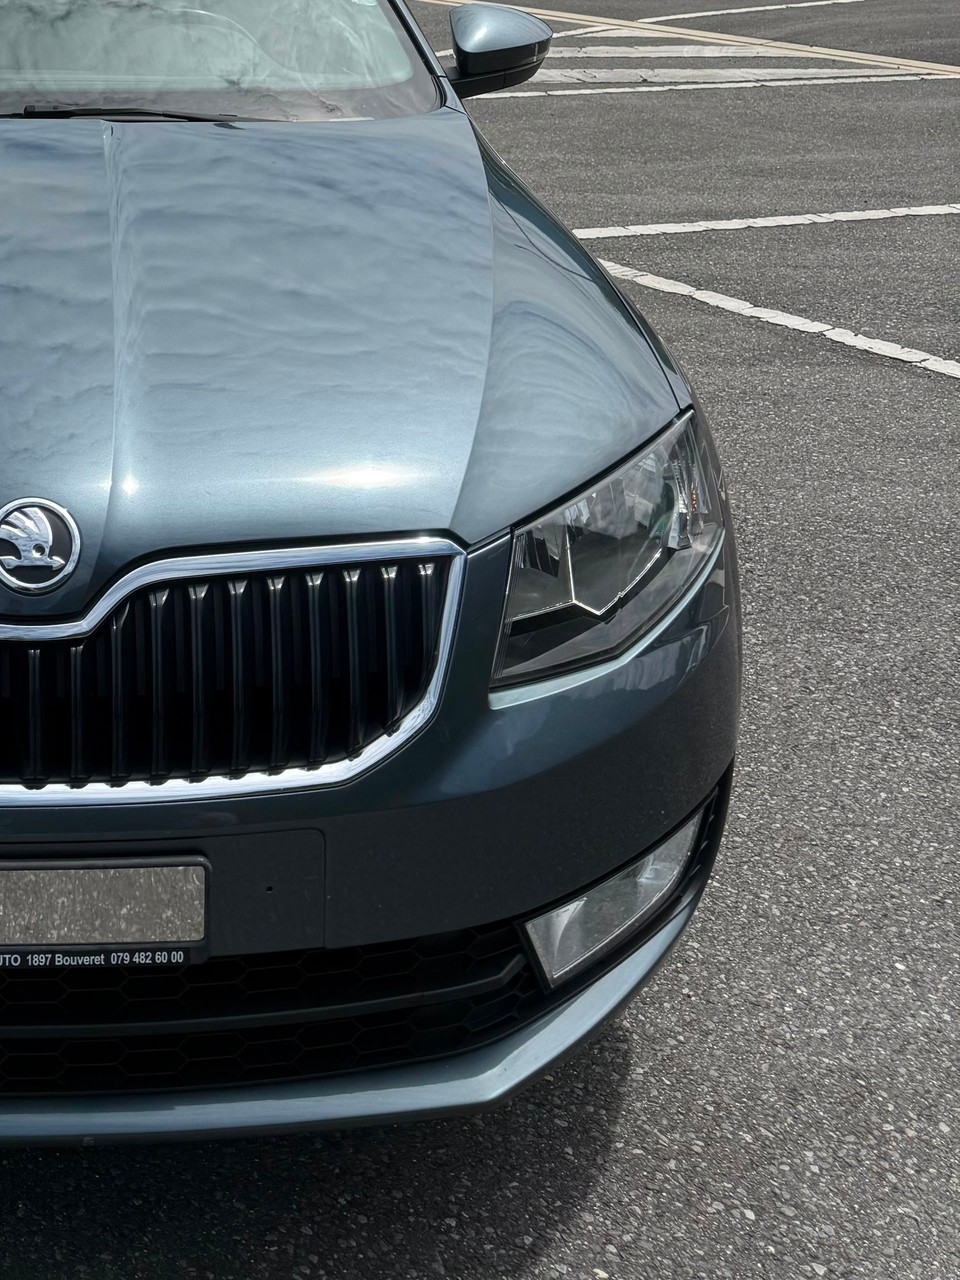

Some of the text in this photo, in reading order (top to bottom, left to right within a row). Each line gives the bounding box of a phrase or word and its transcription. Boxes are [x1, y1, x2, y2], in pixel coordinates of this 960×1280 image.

[26, 954, 52, 966] 1897
[55, 953, 105, 966] Bouveret
[110, 952, 130, 965] 079
[132, 952, 152, 964] 482
[155, 951, 168, 963] 60
[171, 951, 184, 963] 00
